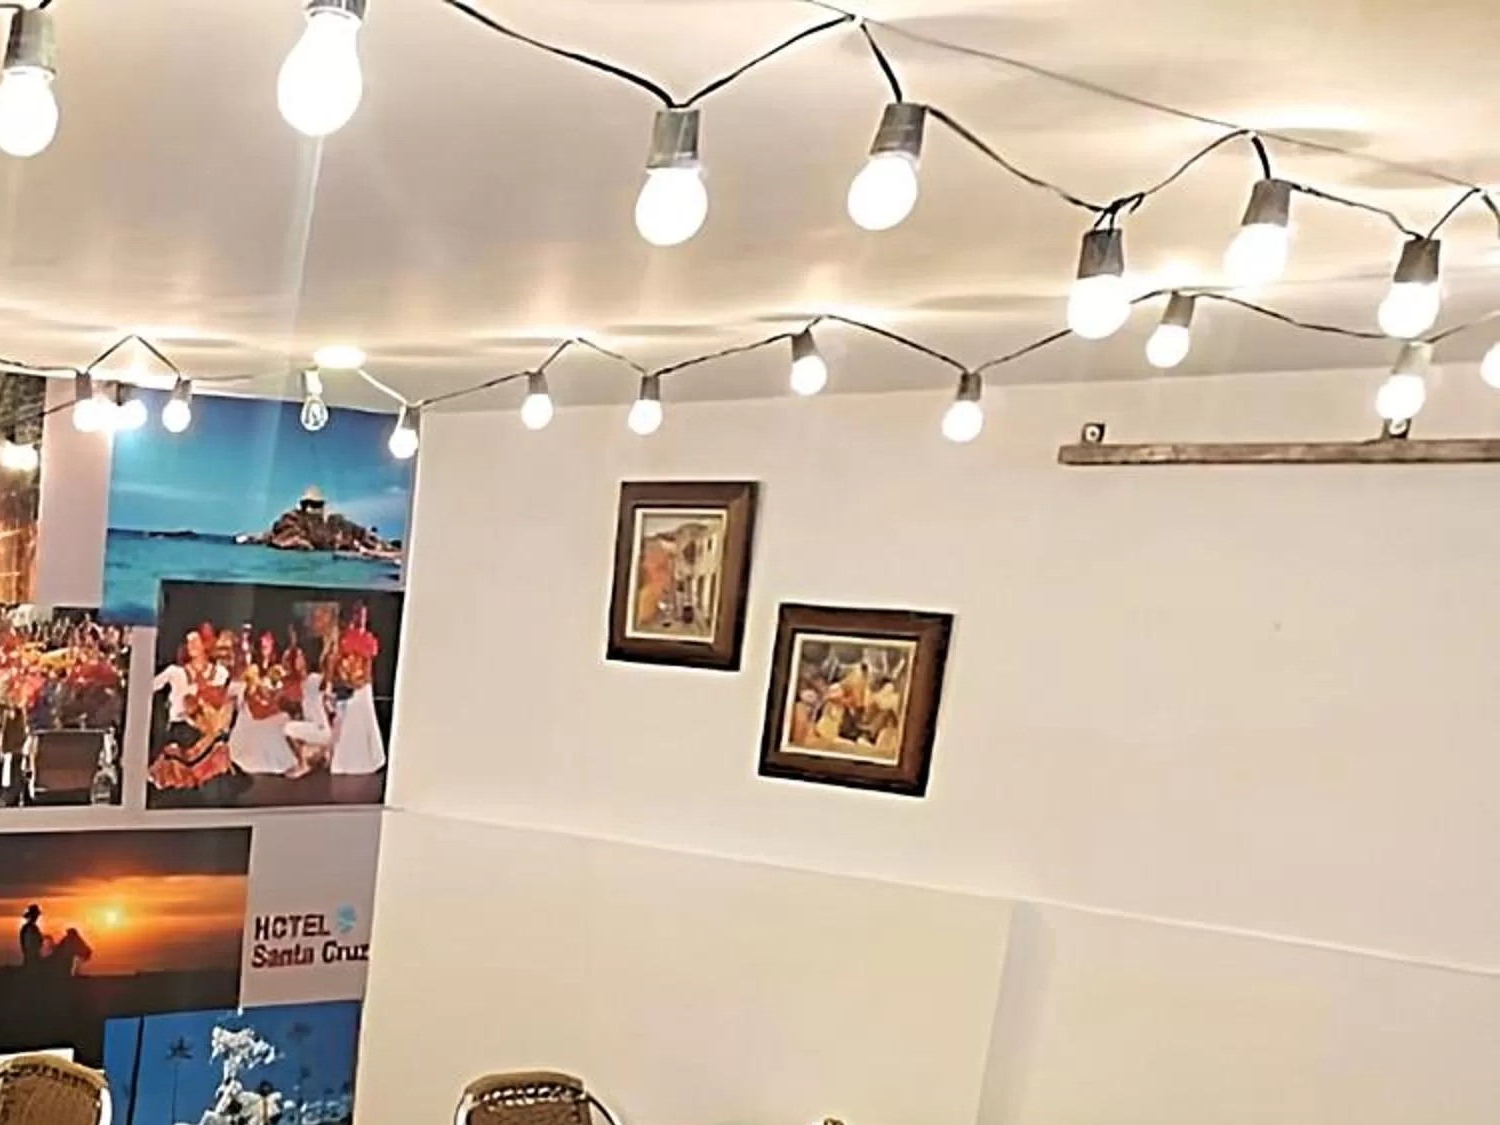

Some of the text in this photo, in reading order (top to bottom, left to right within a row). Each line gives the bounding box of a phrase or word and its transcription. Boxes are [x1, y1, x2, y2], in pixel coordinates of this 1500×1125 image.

[254, 913, 331, 941] HOTEL
[251, 940, 370, 968] Santa Cruz
